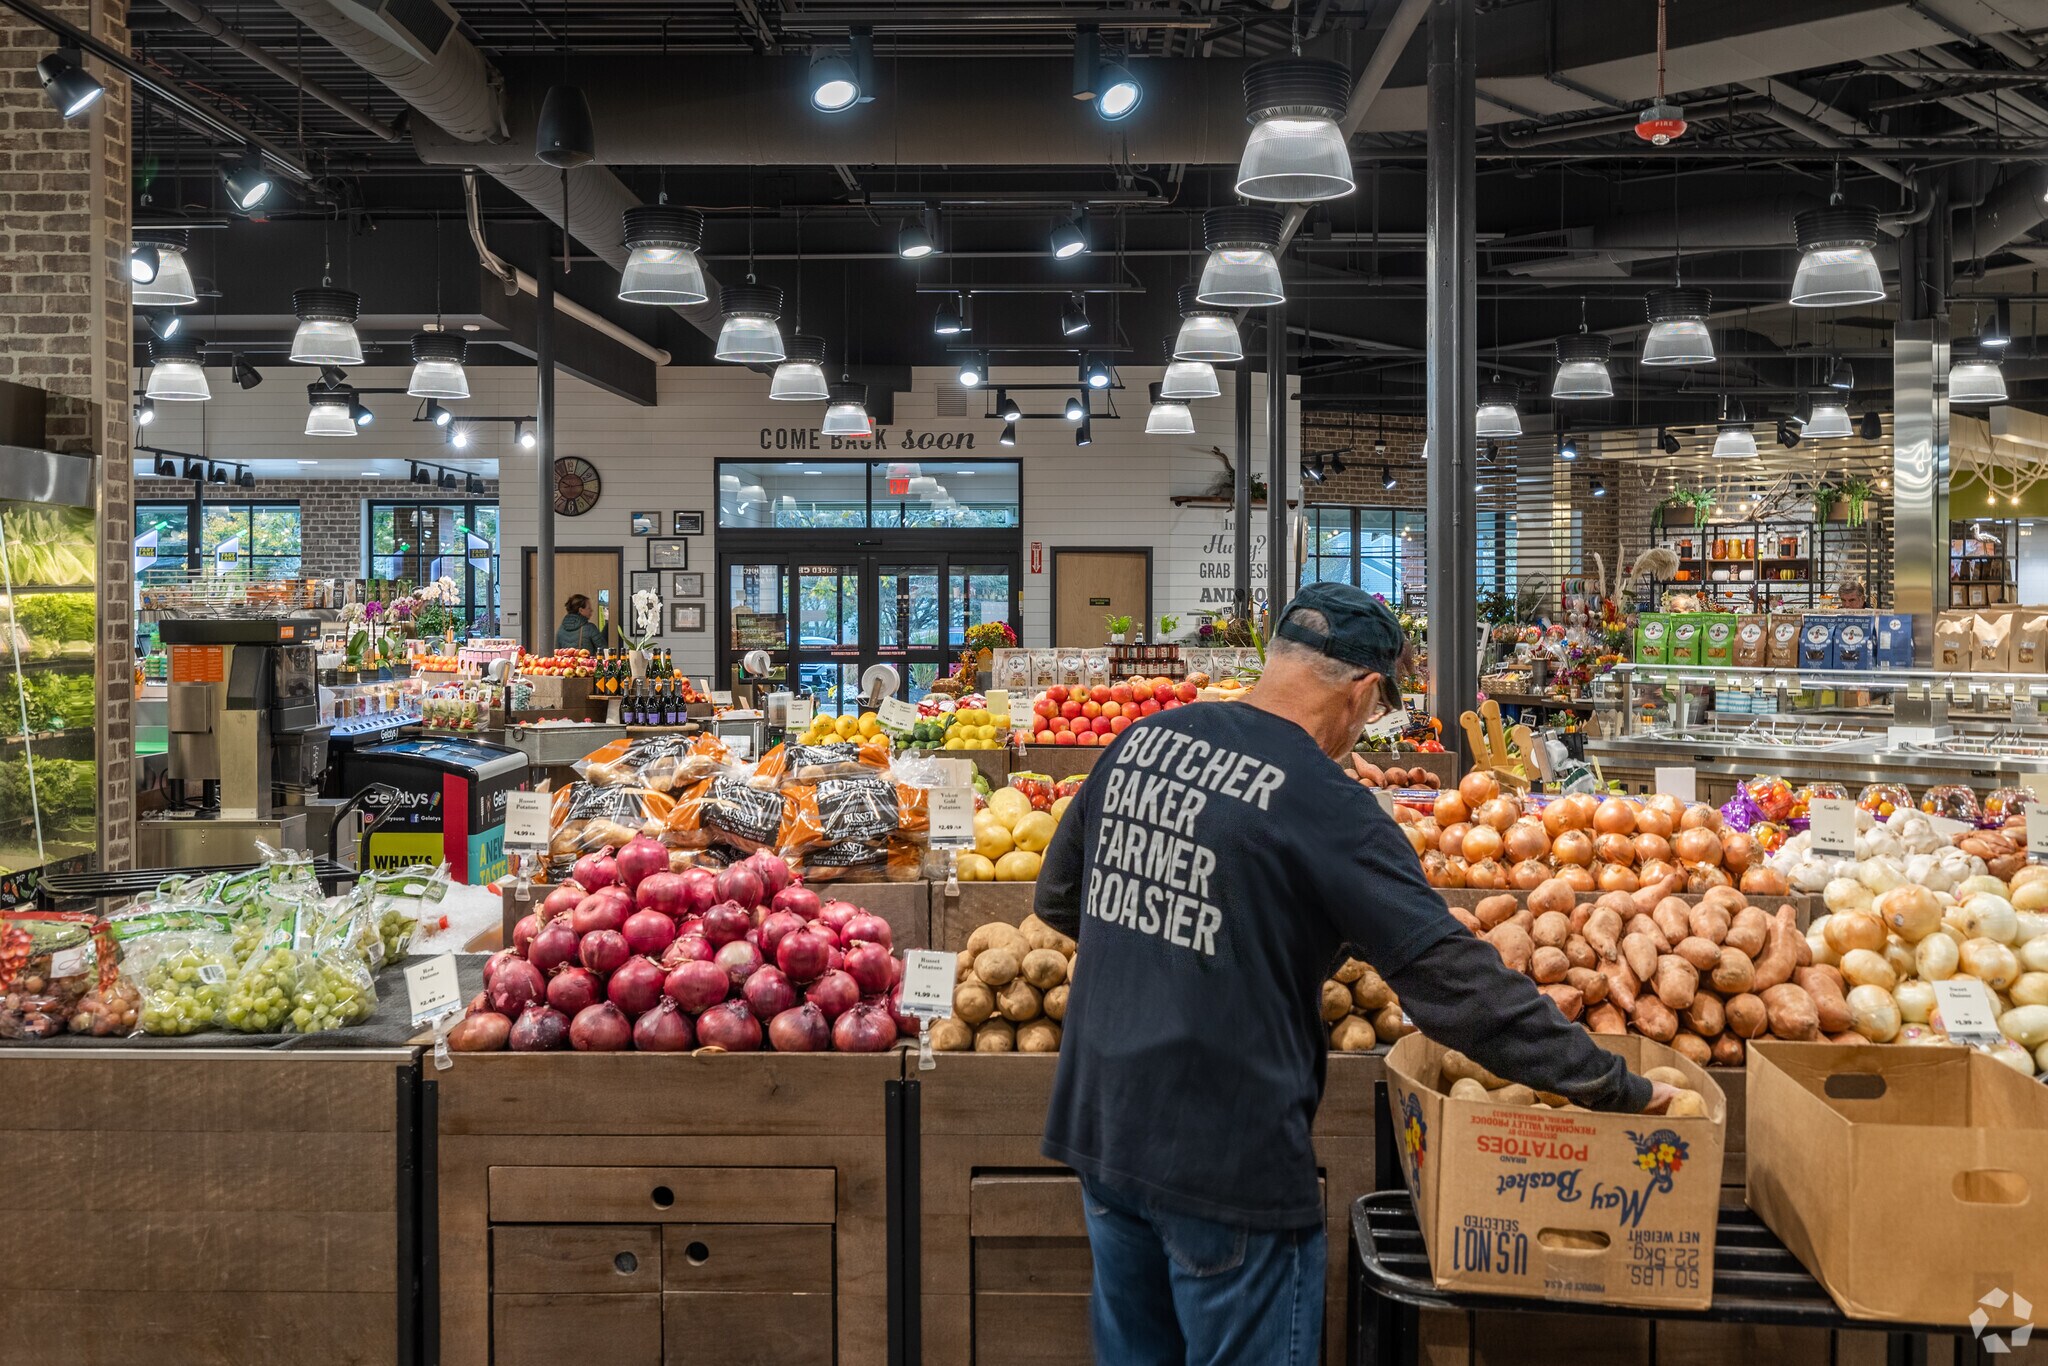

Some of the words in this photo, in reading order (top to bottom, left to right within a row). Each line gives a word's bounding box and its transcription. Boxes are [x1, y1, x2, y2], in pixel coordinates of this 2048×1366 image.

[760, 428, 820, 450] COME
[901, 429, 976, 450] soon
[1203, 533, 1266, 561] Huy?
[1199, 562, 1230, 578] GRAB
[1115, 726, 1286, 811] BUTCHER
[1102, 768, 1207, 837] BAKER
[844, 811, 874, 823] RUSSET
[374, 855, 432, 869] WHAT'S
[479, 843, 487, 868] A
[1094, 818, 1217, 898] FARMER
[1086, 868, 1222, 956] ROASTER
[422, 966, 434, 974] Red
[1470, 1116, 1510, 1128] PRODUCE
[1511, 1120, 1542, 1131] VALLEY
[1544, 1123, 1596, 1135] FRENCHMAN
[1517, 1129, 1558, 1140] DISTRIBUTED
[1476, 1135, 1588, 1162] POTATOES
[1500, 1156, 1527, 1164] BRAND
[1496, 1168, 1583, 1203] Basket
[1590, 1177, 1666, 1229] May
[1464, 1214, 1519, 1232] SELECTED
[1627, 1229, 1674, 1242] WEIGHT
[1679, 1231, 1700, 1243] NET
[1675, 1267, 1700, 1288] 50
